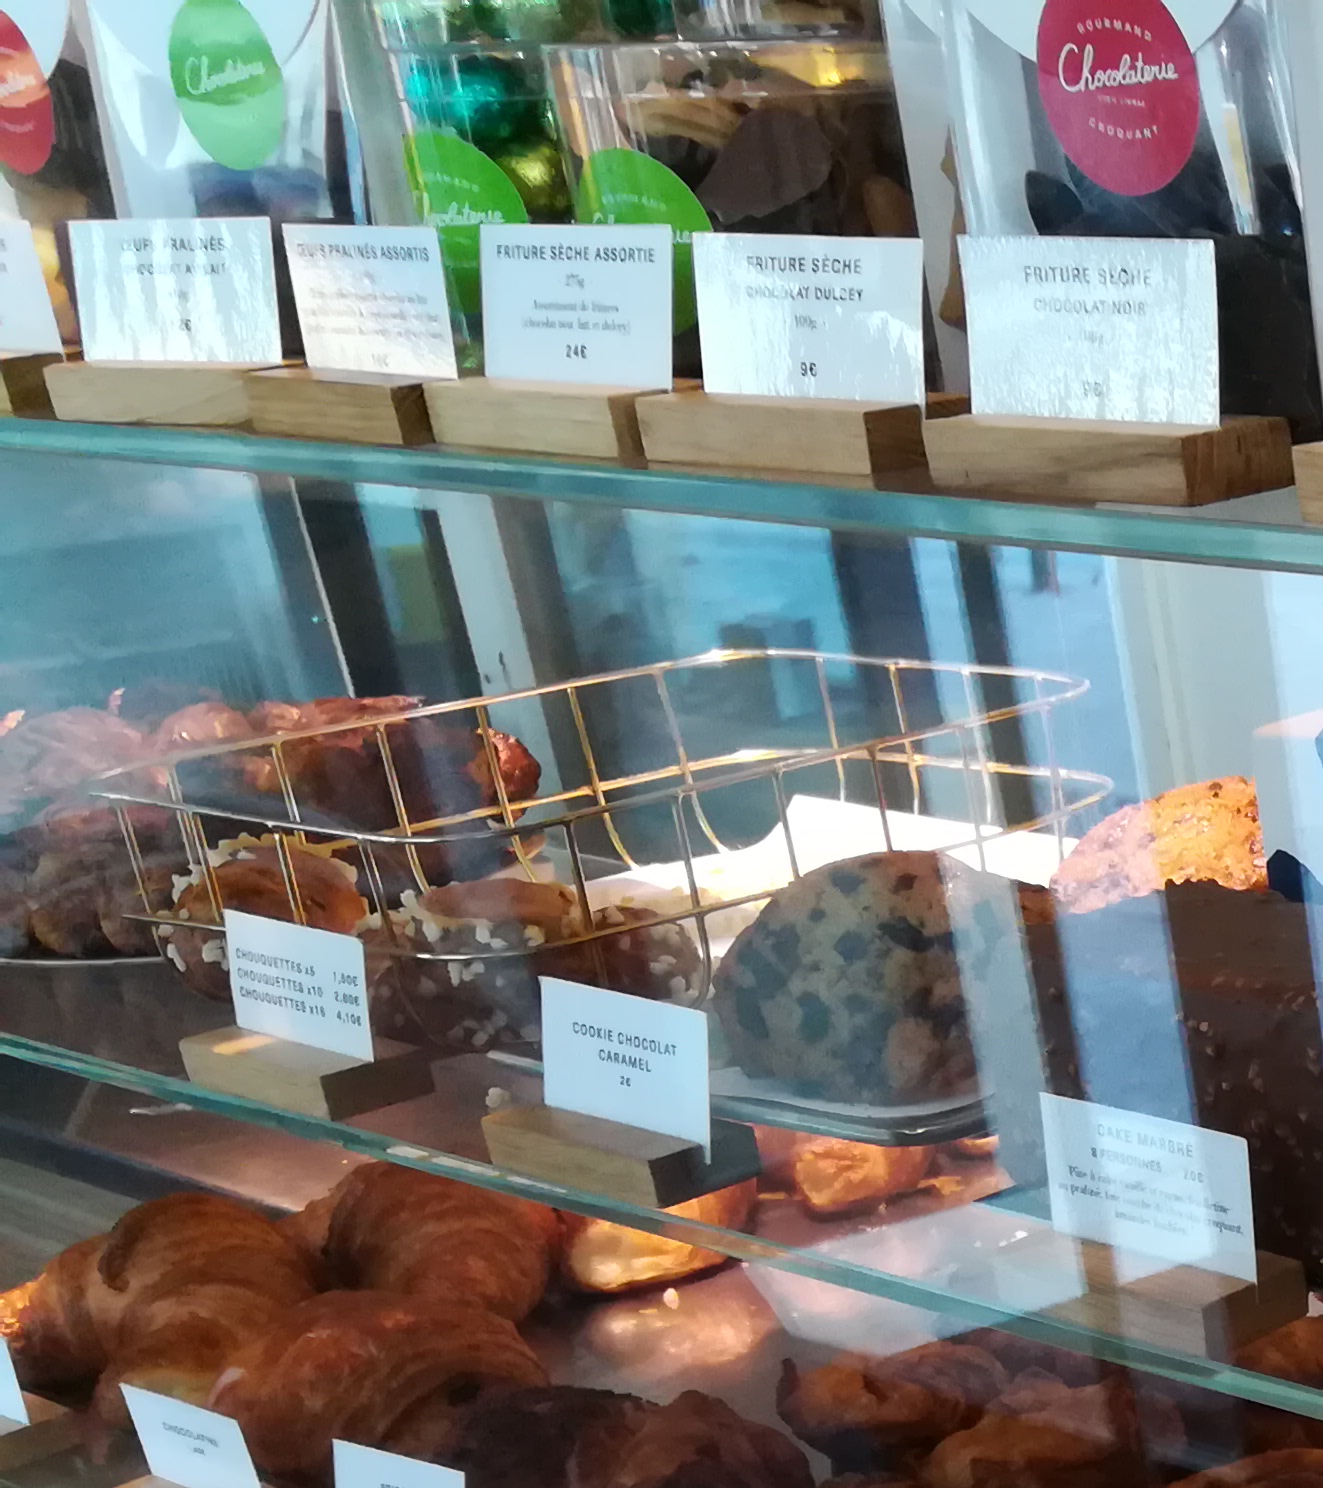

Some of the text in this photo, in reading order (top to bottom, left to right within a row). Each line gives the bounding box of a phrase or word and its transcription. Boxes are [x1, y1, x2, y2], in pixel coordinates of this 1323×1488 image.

[1058, 43, 1179, 92] Chocolaterie
[1089, 117, 1159, 139] CROQUANT
[380, 246, 429, 262] ASSORTIS
[496, 243, 655, 263] FRITURE SÈCHE ASSORTIE
[747, 254, 861, 274] FRITURE SÈCHE
[1024, 265, 1090, 284] FRITURE
[1033, 298, 1146, 316] CHOCOLAT NOIR
[800, 362, 817, 377] 9€
[235, 948, 302, 974] CHOUQUETTES
[305, 966, 315, 976] x5
[237, 968, 304, 993] CHOUQUETTES
[307, 986, 323, 997] x10
[239, 986, 306, 1013] CHOUQUETTES
[572, 1022, 677, 1056] COOKIE CHOCOLAT
[599, 1049, 652, 1072] CARAMEL
[620, 1076, 631, 1087] 2€
[1098, 1124, 1132, 1143] CAKE
